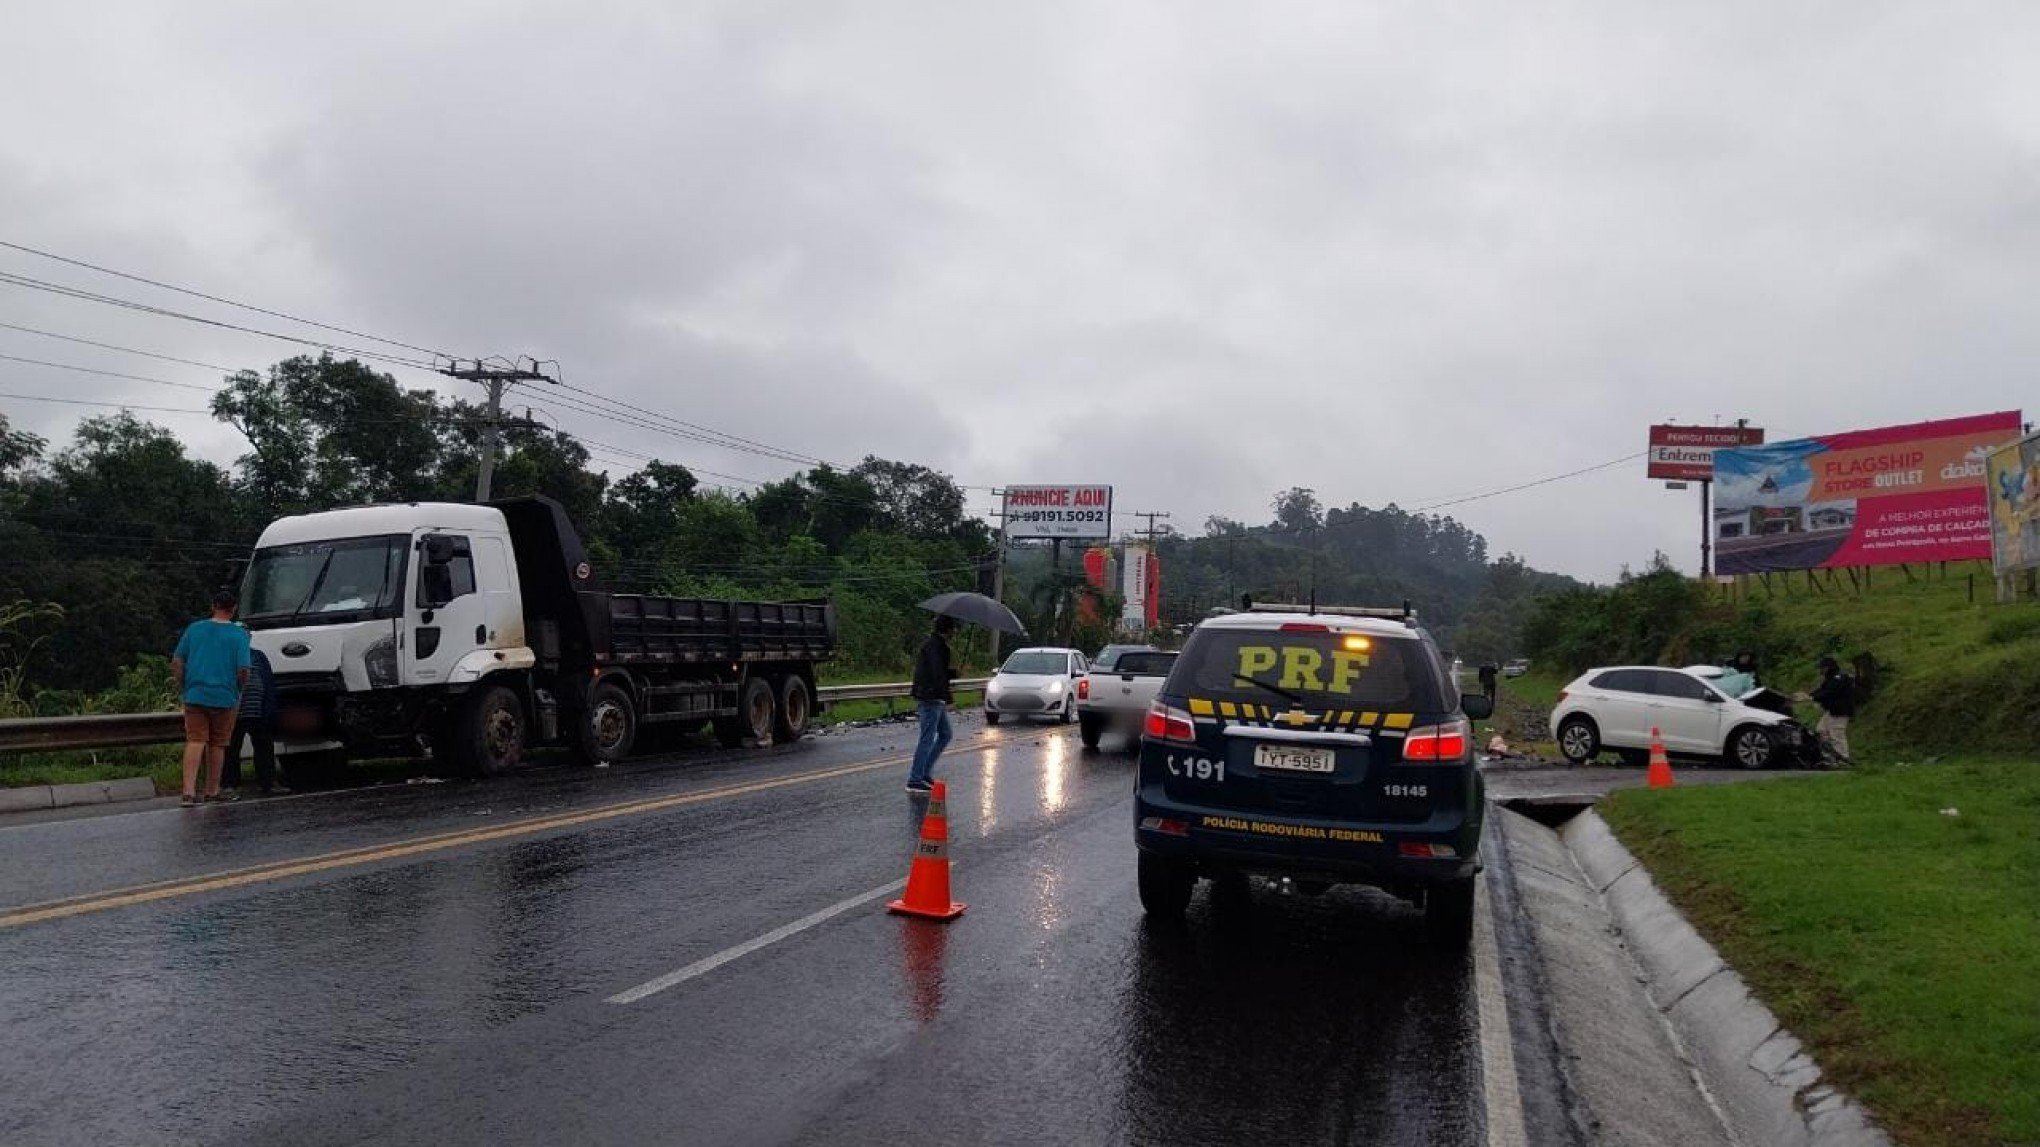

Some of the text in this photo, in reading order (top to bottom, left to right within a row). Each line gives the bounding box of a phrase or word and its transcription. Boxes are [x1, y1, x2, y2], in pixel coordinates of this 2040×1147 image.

[1825, 451, 1924, 476] FLAGSHIP
[1824, 470, 1923, 493] STORE OUTLET
[1010, 489, 1105, 506] ANUNCIE AQUI
[1865, 529, 1879, 538] DE
[1928, 523, 1942, 533] DE
[1234, 646, 1369, 693] PRF
[1184, 757, 1224, 781] 191
[1383, 784, 1428, 797] 18145
[1203, 816, 1384, 842] POLÍCIA RODOVIÁRIA FEDERAL
